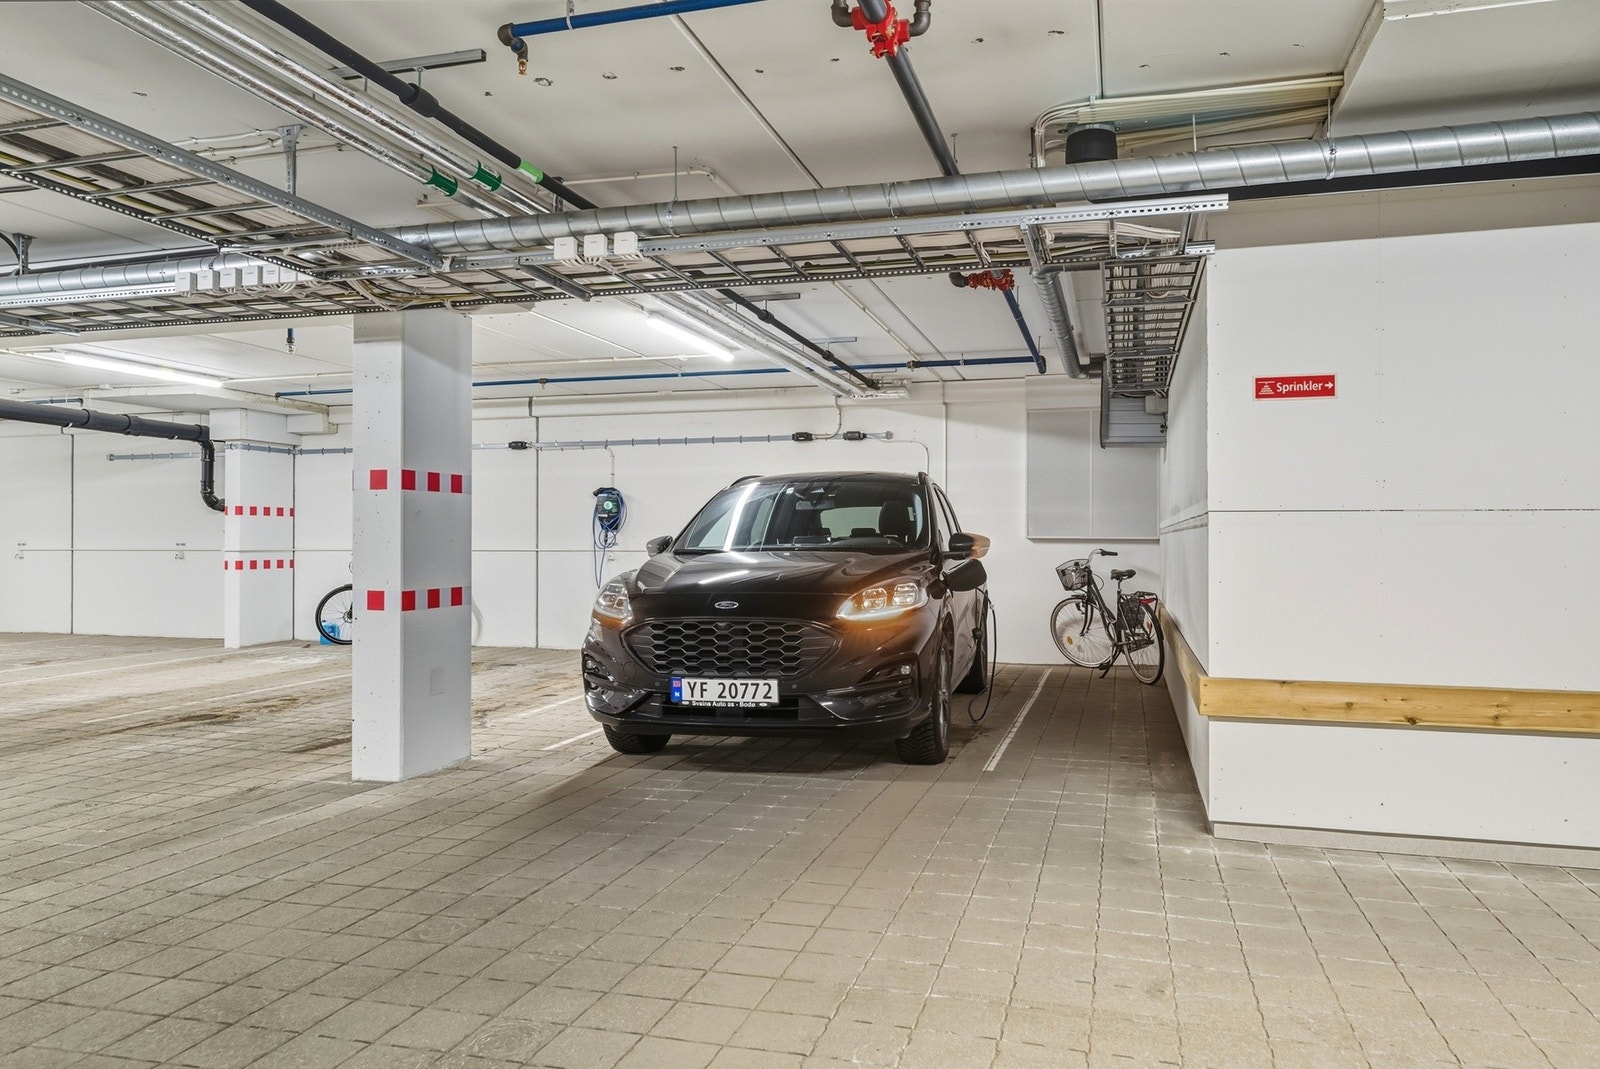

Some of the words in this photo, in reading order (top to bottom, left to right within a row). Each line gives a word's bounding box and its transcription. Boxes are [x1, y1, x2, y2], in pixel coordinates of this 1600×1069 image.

[1276, 380, 1323, 394] Sprinkler
[687, 681, 708, 698] YF
[717, 682, 773, 700] 20772
